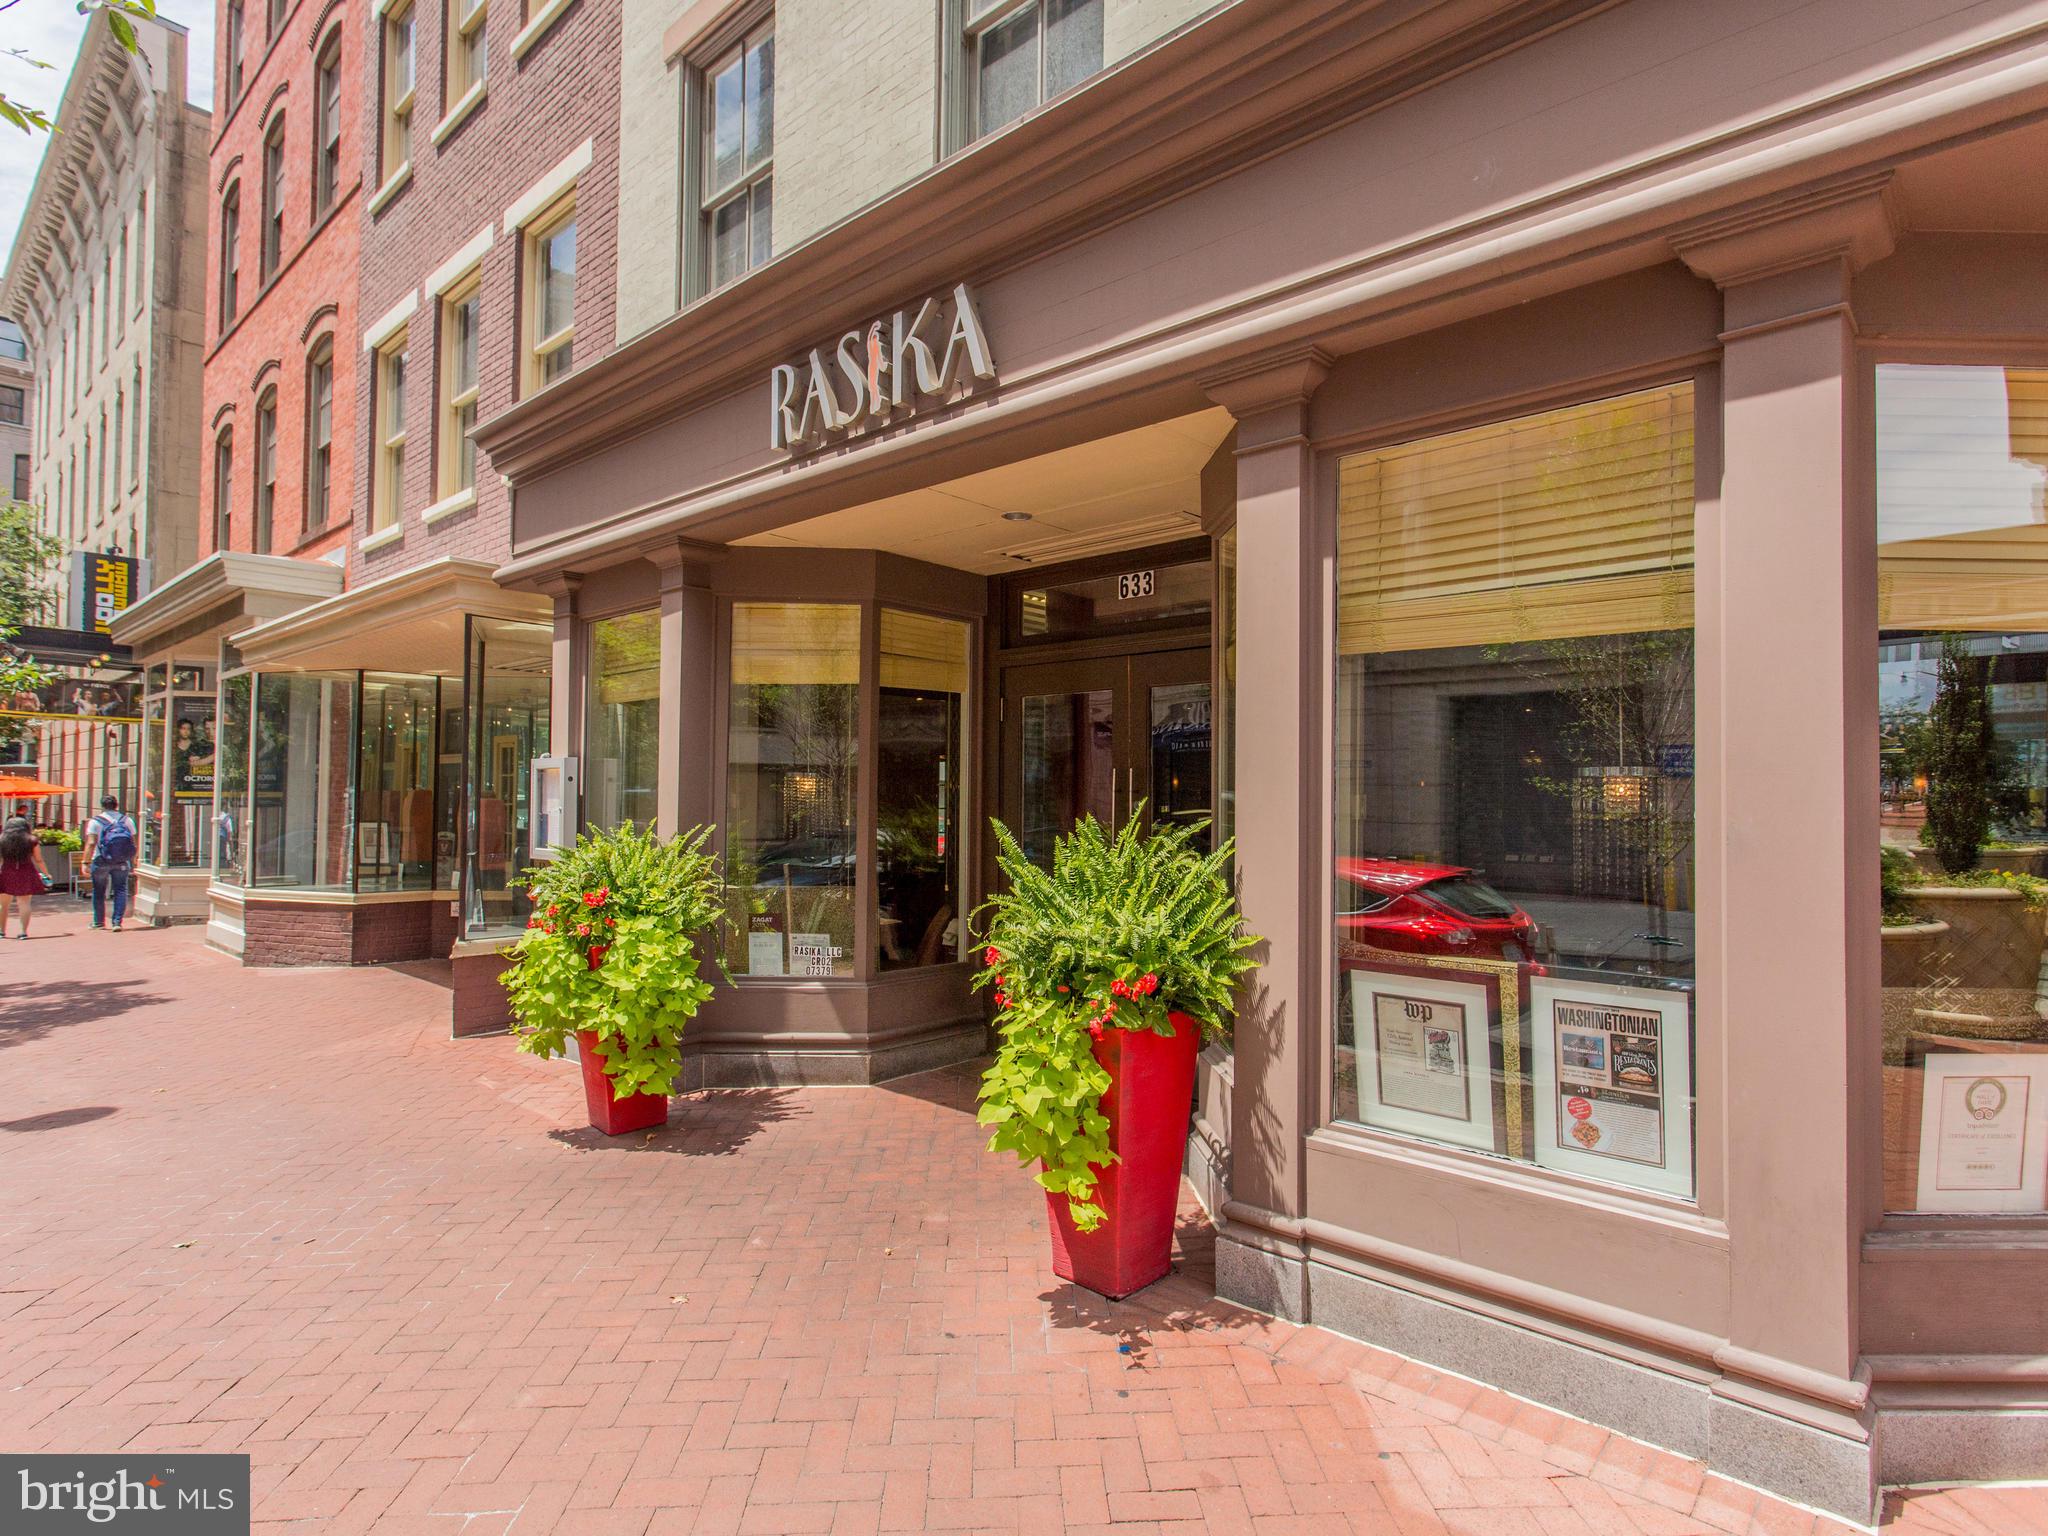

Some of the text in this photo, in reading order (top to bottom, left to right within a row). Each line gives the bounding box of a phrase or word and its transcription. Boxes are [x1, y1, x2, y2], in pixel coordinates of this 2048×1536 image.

[771, 283, 995, 451] RASIKA
[113, 561, 128, 616] MAMM
[1120, 572, 1152, 598] 633
[794, 946, 841, 956] RASIKA LLC
[811, 957, 831, 966] CR02
[1557, 1006, 1658, 1037] WASHINGTONIAN
